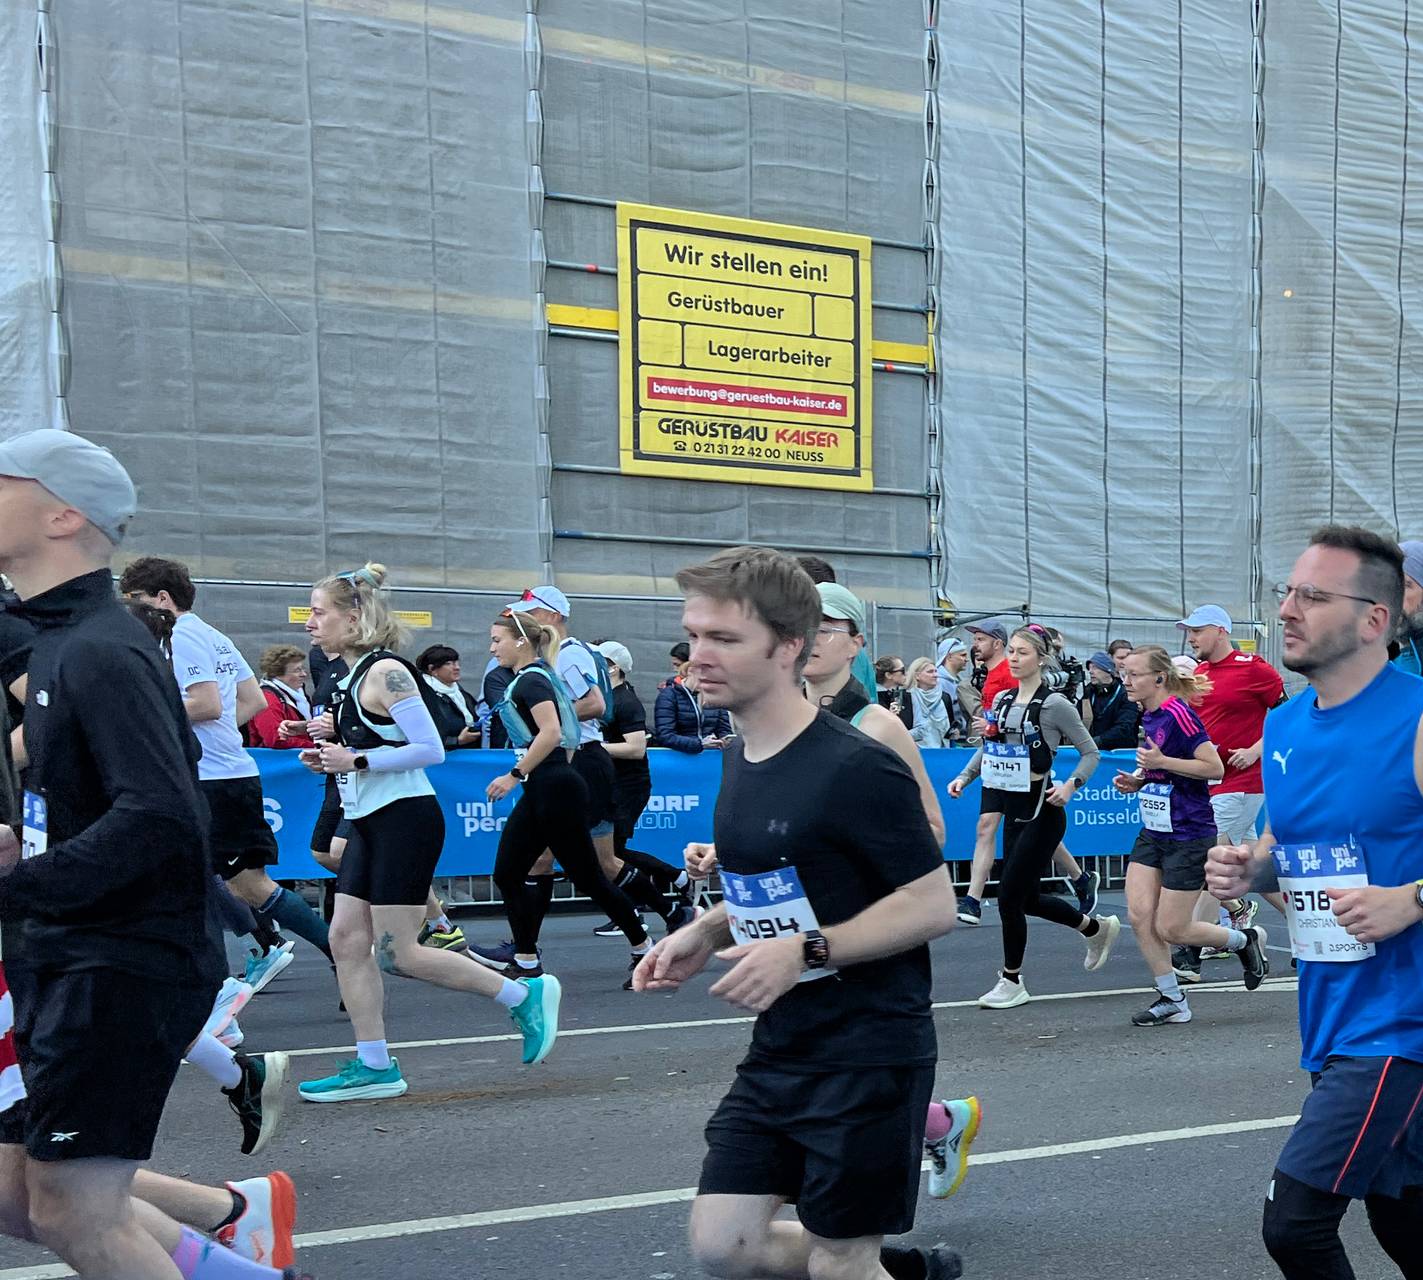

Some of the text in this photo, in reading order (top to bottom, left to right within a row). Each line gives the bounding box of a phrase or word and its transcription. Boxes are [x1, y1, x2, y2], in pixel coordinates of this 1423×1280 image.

[664, 242, 828, 283] Wir stellen ein!
[668, 291, 785, 319] Gerüstbauer
[708, 340, 832, 368] Lagerarbeiter
[653, 382, 842, 411] bewerbung@geruestbau-kaiser.de
[658, 417, 839, 449] GERÜSTBAU KAISER
[786, 450, 824, 462] NEUSS
[456, 800, 493, 818] uni
[1074, 808, 1140, 825] Düsseld
[1297, 845, 1317, 860] uni
[1331, 844, 1350, 858] uni
[1302, 859, 1322, 874] per
[1336, 856, 1358, 872] per
